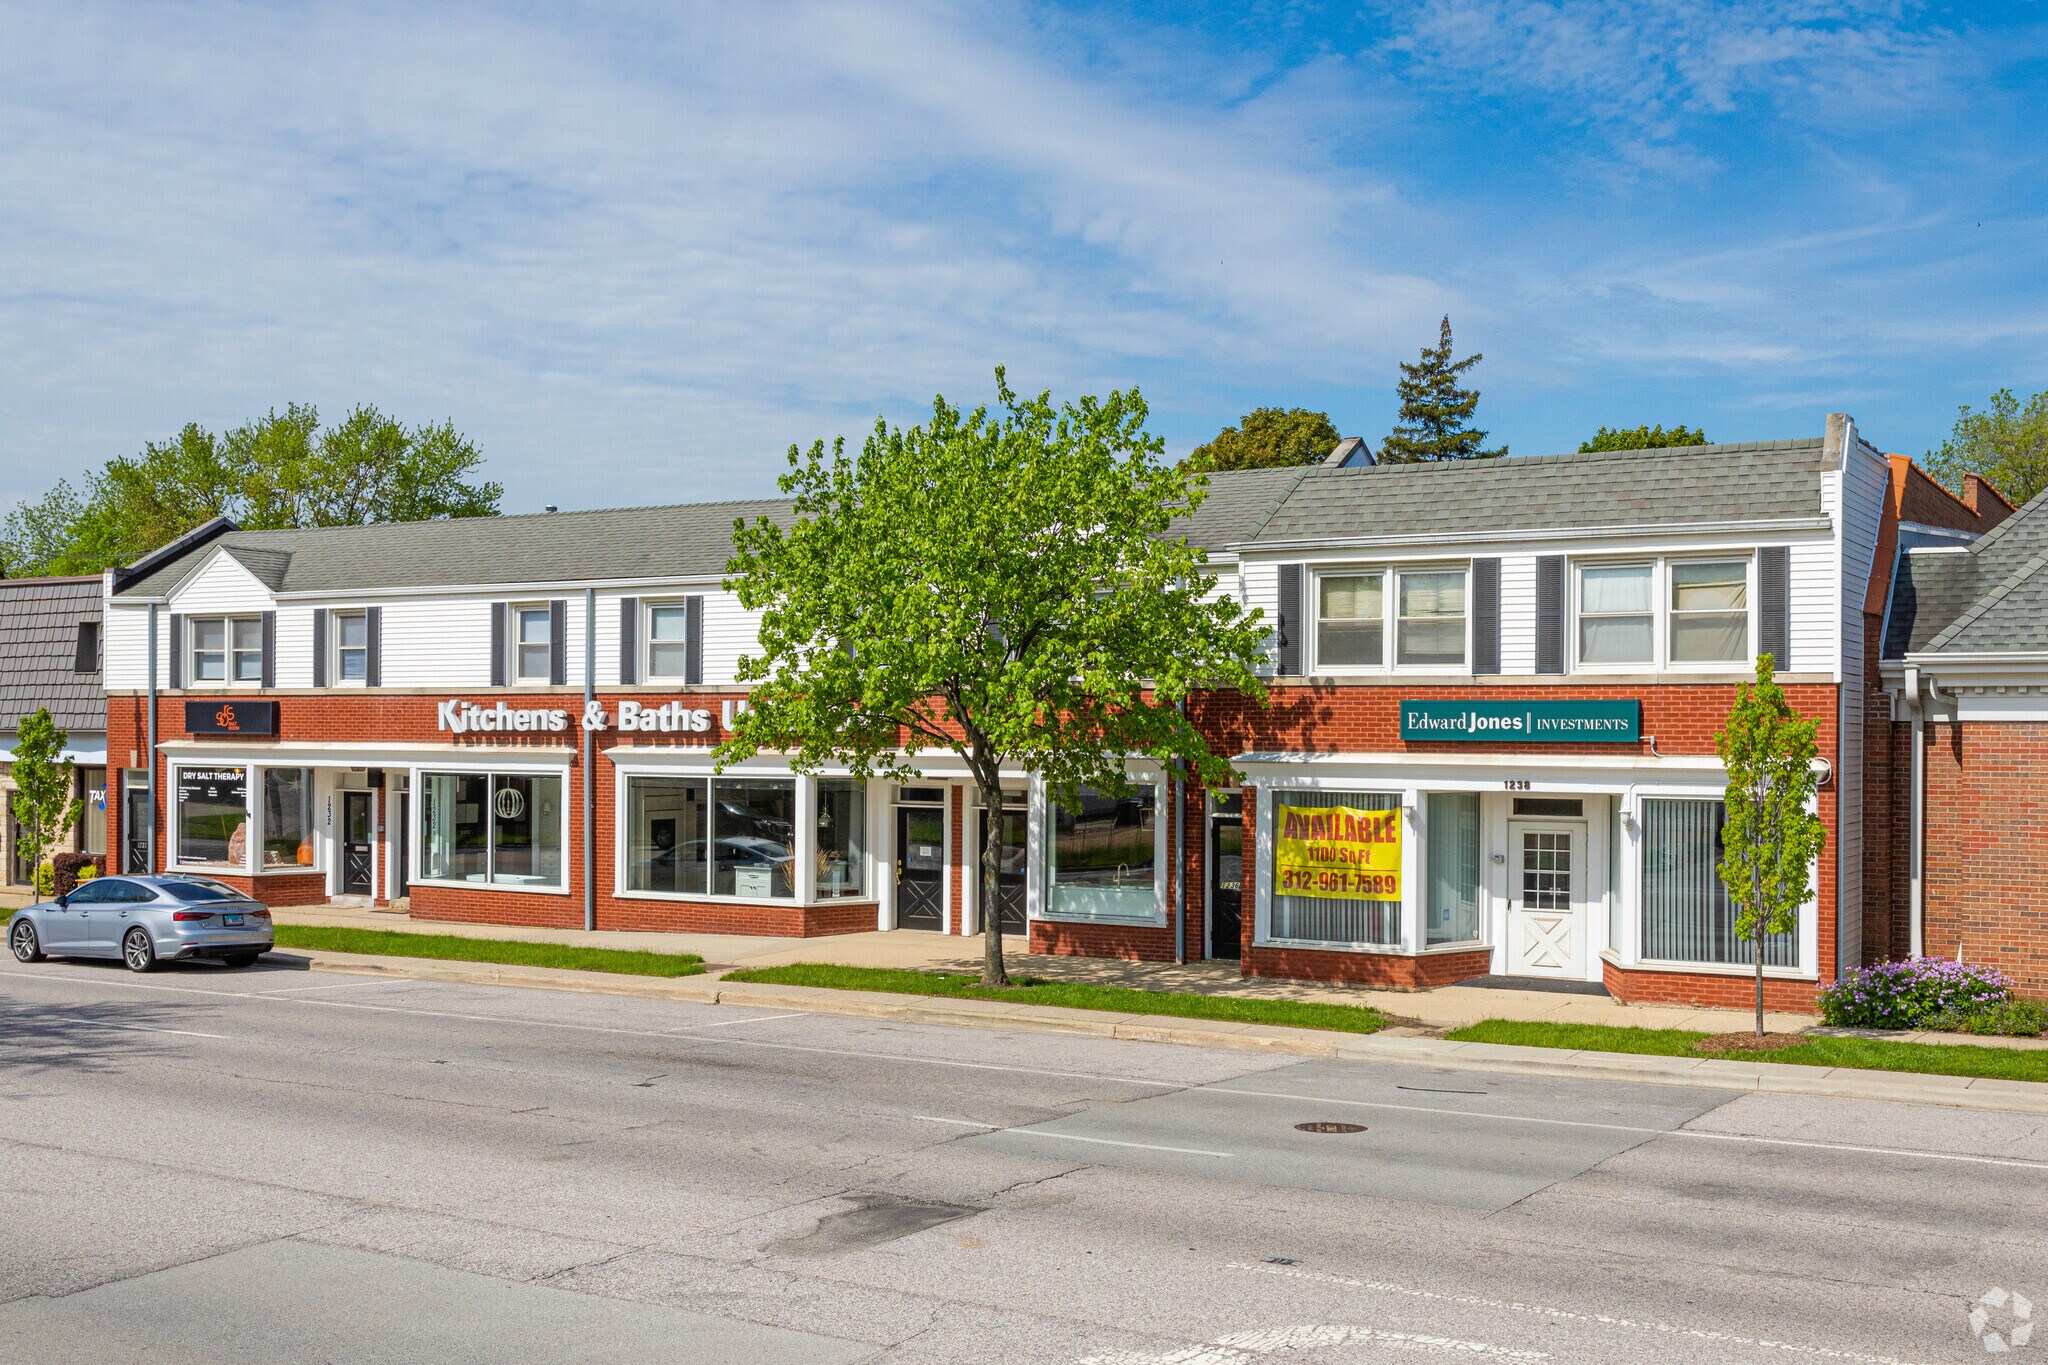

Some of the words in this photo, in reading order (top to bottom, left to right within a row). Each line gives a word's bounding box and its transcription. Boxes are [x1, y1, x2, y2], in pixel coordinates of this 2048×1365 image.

[438, 699, 568, 733] Kitchens
[582, 700, 608, 731] &
[618, 700, 711, 732] Baths
[1537, 719, 1628, 730] INVESTMENTS
[183, 772, 196, 780] DRY
[197, 772, 213, 780] SALT
[213, 772, 245, 781] THERAPY
[1503, 780, 1531, 790] 1238
[89, 789, 107, 807] TAX
[1283, 811, 1397, 843] AVAILABLE
[1307, 847, 1336, 862] 1100
[1340, 848, 1356, 865] Sq
[1358, 849, 1371, 864] Ft
[1283, 869, 1397, 894] 312-961-7589
